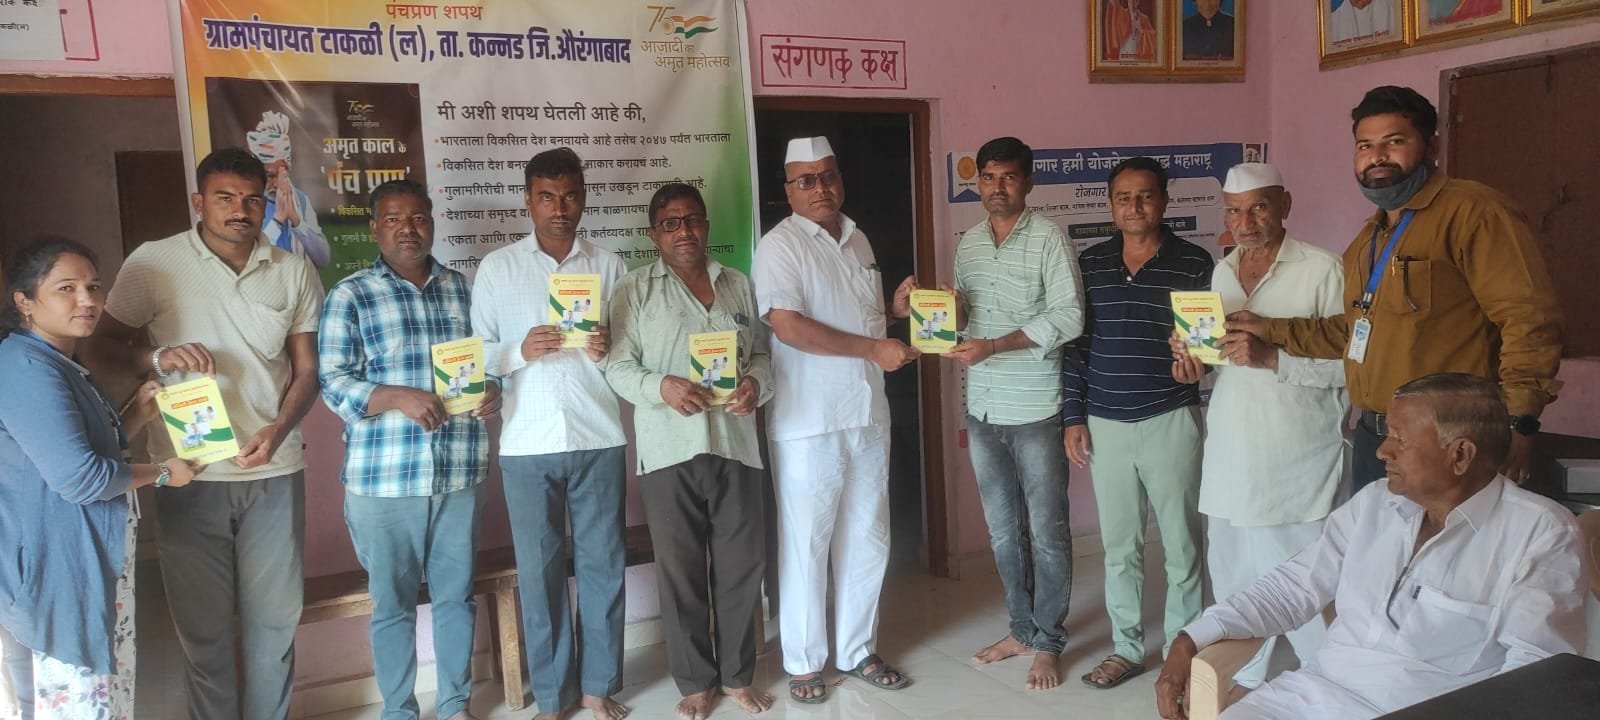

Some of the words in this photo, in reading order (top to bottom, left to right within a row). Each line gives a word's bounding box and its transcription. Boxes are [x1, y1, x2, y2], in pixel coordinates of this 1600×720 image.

[386, 0, 438, 19] पंचप्रण
[443, 6, 483, 20] शपथ
[202, 14, 315, 53] ग्रामपंचायत
[316, 21, 383, 56] टाकळी
[436, 30, 464, 58] ता.
[466, 32, 525, 60] कन्नड
[655, 56, 684, 73] अमृत
[687, 52, 730, 71] महोत्सव
[860, 49, 899, 81] कक्ष
[437, 101, 456, 120] मी
[461, 101, 496, 121] अशी
[501, 106, 539, 120] शपथ
[544, 101, 587, 121] घेतली
[591, 103, 620, 122] आहे
[623, 102, 647, 123] की,
[322, 137, 359, 159] अमृत
[361, 137, 395, 154] काल
[398, 141, 407, 154] के
[440, 136, 484, 146] भारताला
[487, 133, 527, 147] विकसित
[531, 133, 547, 146] देश
[550, 133, 589, 146] बनवायचे
[592, 133, 611, 147] आहे
[614, 133, 636, 145] तसेच
[640, 135, 667, 145] २०४७
[694, 133, 731, 144] भारताला
[443, 158, 485, 171] विकसित
[488, 158, 504, 171] देश
[507, 161, 528, 170] बनव
[649, 155, 672, 168] आहे.
[1061, 152, 1084, 175] हमी
[1087, 151, 1128, 170] योजने
[1173, 153, 1212, 170] महाराष्ट्र
[445, 182, 504, 200] गुलामगिरीची
[508, 185, 526, 195] मान
[608, 182, 640, 196] उखडून
[446, 208, 485, 220] देशाच्या
[448, 235, 477, 246] एकता
[480, 231, 507, 244] आणि
[590, 226, 633, 239] कर्तव्यदक्ष
[449, 256, 481, 269] नागरि
